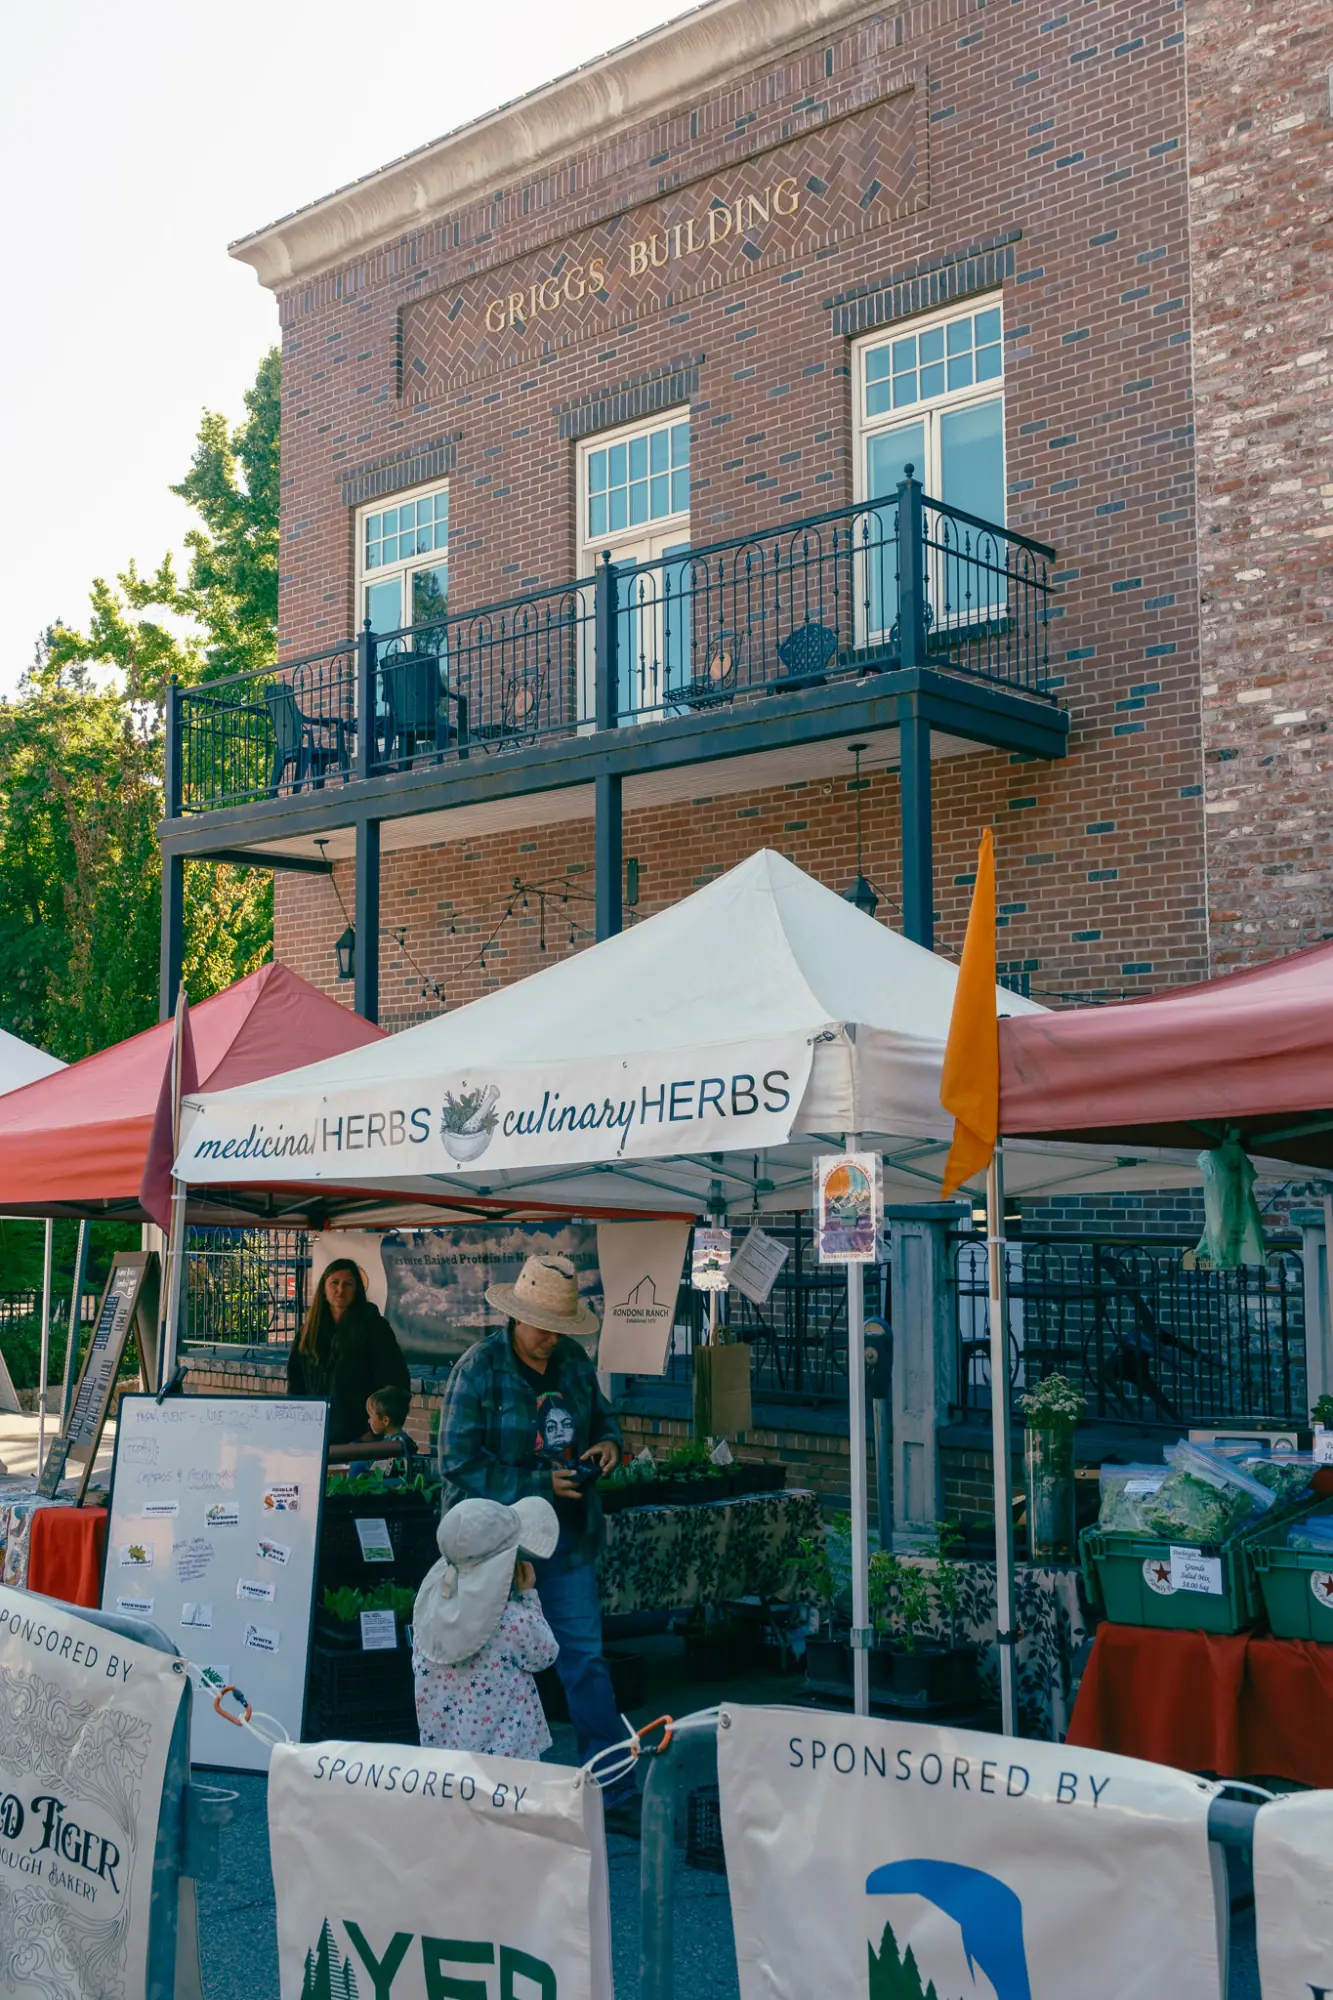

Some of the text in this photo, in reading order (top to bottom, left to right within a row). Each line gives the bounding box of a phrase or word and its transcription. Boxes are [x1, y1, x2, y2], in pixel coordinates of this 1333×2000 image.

[486, 177, 800, 332] GRIGGS BUILDING
[640, 1070, 790, 1125] HERBS
[322, 1107, 432, 1153] HERBS
[424, 1254, 457, 1266] Raised
[459, 1253, 501, 1265] Protein
[502, 1252, 514, 1263] in
[612, 1309, 669, 1317] RONDONI RANCH
[1180, 1571, 1197, 1580] Salad
[1199, 1582, 1210, 1592] bag
[242, 1586, 271, 1595] COMFREY
[249, 1641, 274, 1651] YARROW
[253, 1636, 272, 1644] WHITE
[106, 1655, 133, 1682] BY
[313, 1756, 528, 1812] SPONSORED BY
[789, 1737, 1111, 1809] SPONSORED BY
[0, 1791, 24, 1839] D
[0, 1845, 42, 1876] OUGH
